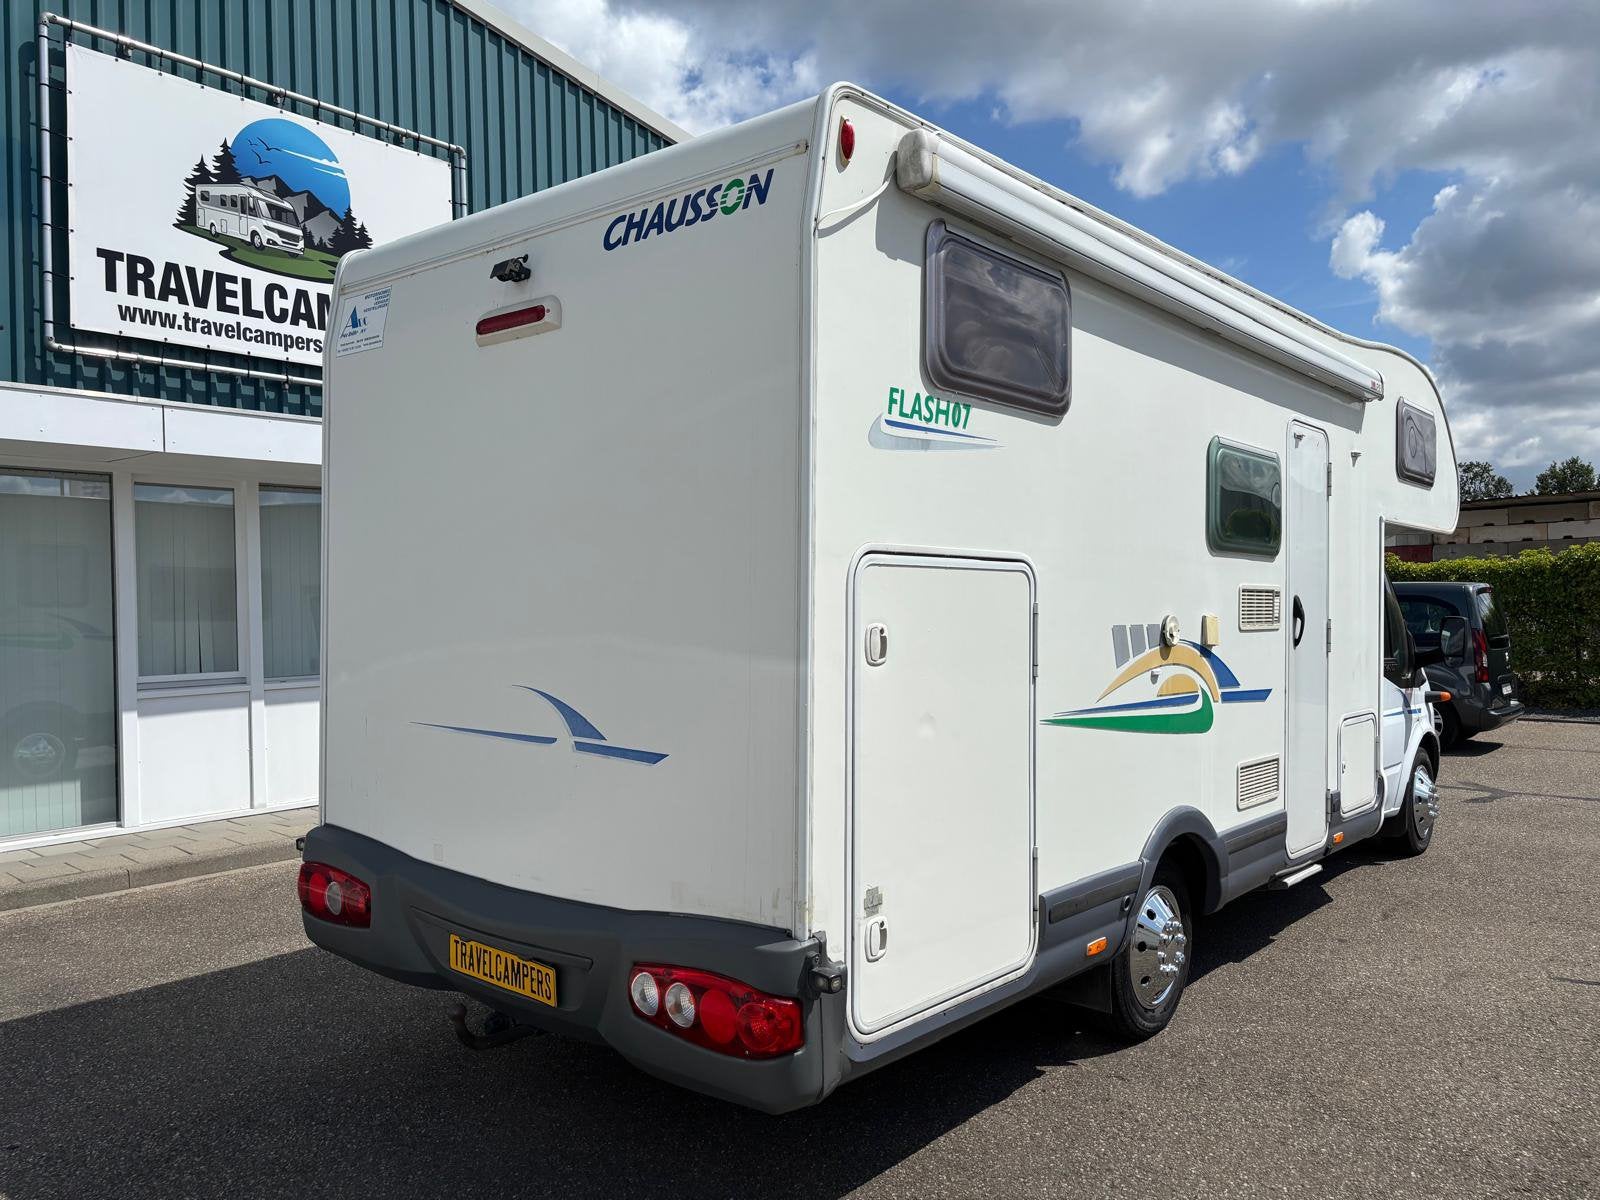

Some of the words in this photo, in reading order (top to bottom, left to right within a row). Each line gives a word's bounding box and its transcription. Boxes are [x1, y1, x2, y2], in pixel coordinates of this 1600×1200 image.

[603, 168, 774, 251] CHAUSSON
[117, 304, 323, 353] www.travelcampers
[454, 940, 552, 1000] TRAVELCAMPERS
